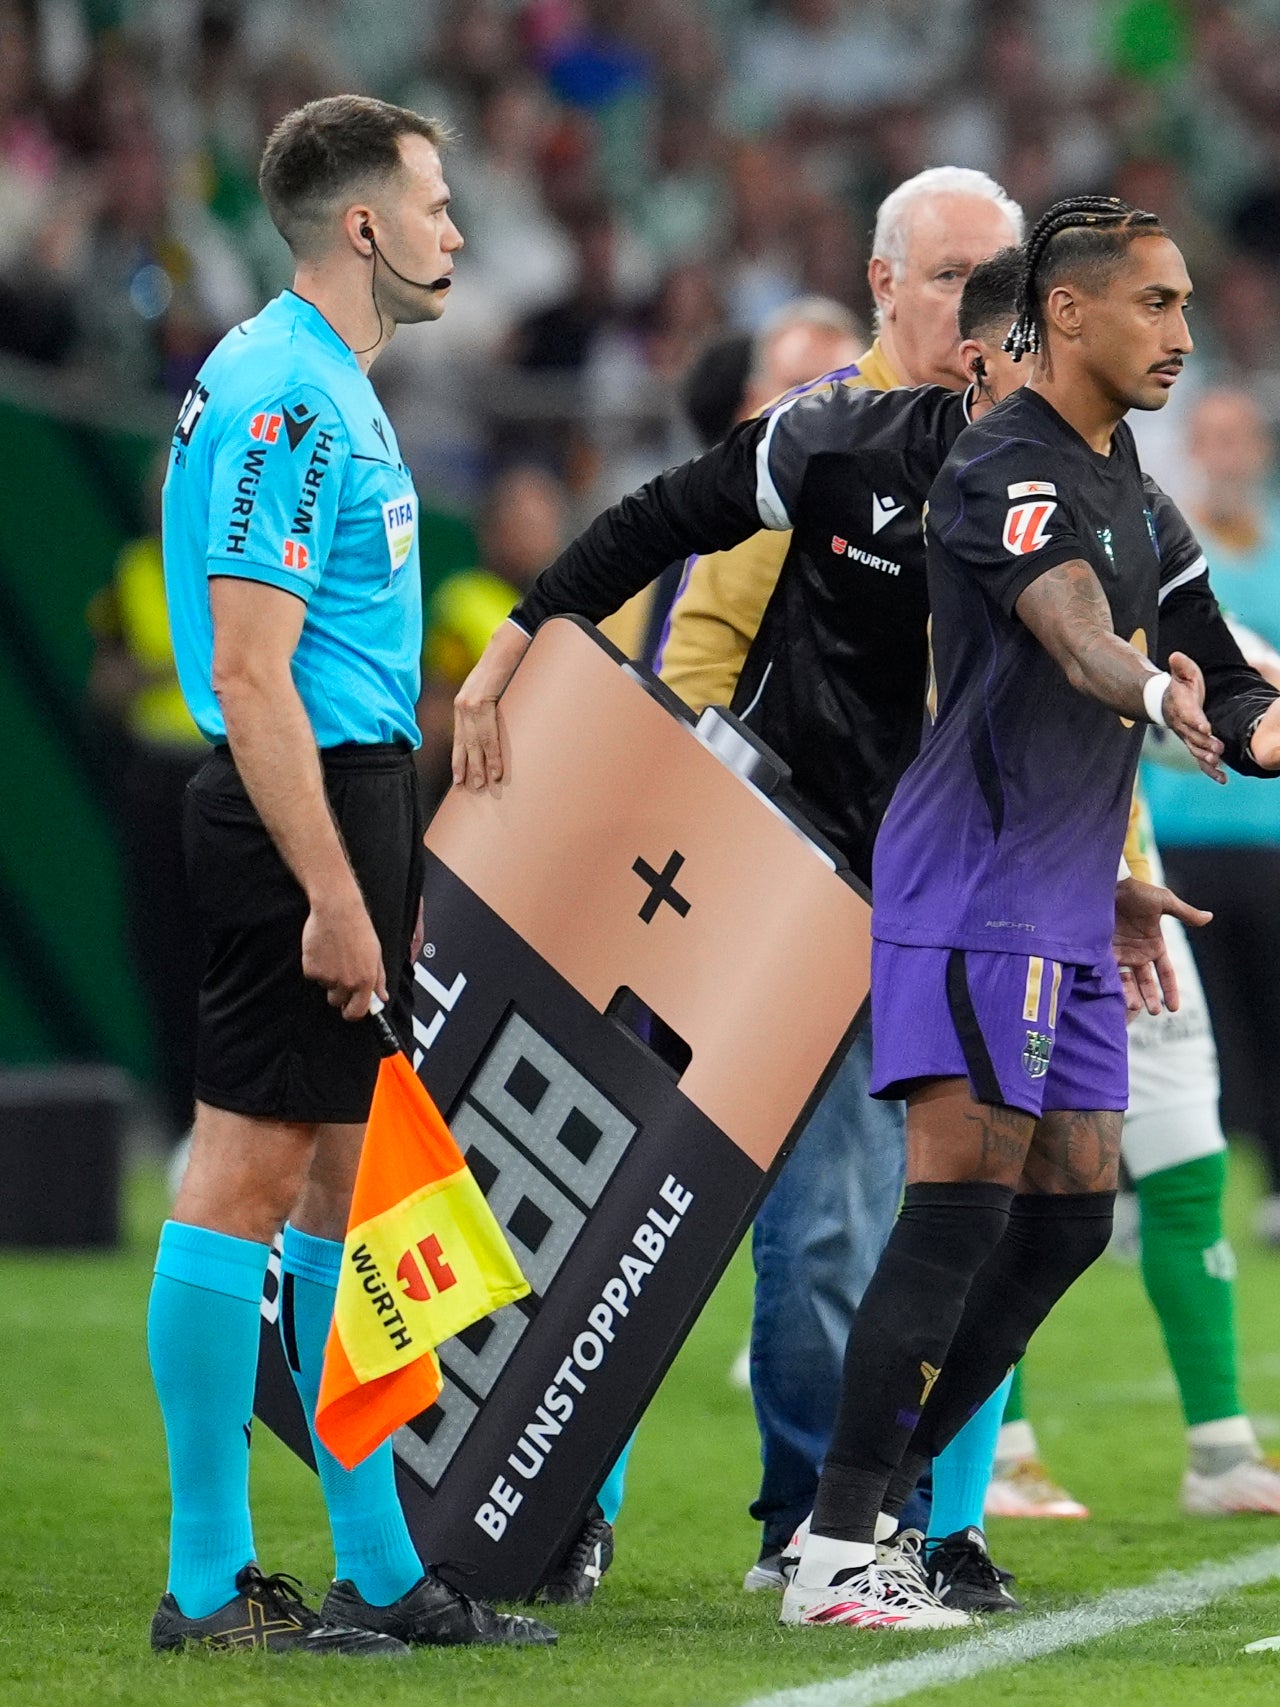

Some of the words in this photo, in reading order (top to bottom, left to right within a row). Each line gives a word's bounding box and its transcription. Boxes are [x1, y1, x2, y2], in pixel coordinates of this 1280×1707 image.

[226, 449, 267, 554] WÜRTH
[290, 431, 333, 535] WÜRTH
[387, 503, 413, 529] FIFA
[847, 545, 901, 576] WÜRTH
[351, 1243, 413, 1352] WÜRTH
[474, 1474, 524, 1542] BE
[507, 1174, 694, 1480] UNSTOPPABLE
